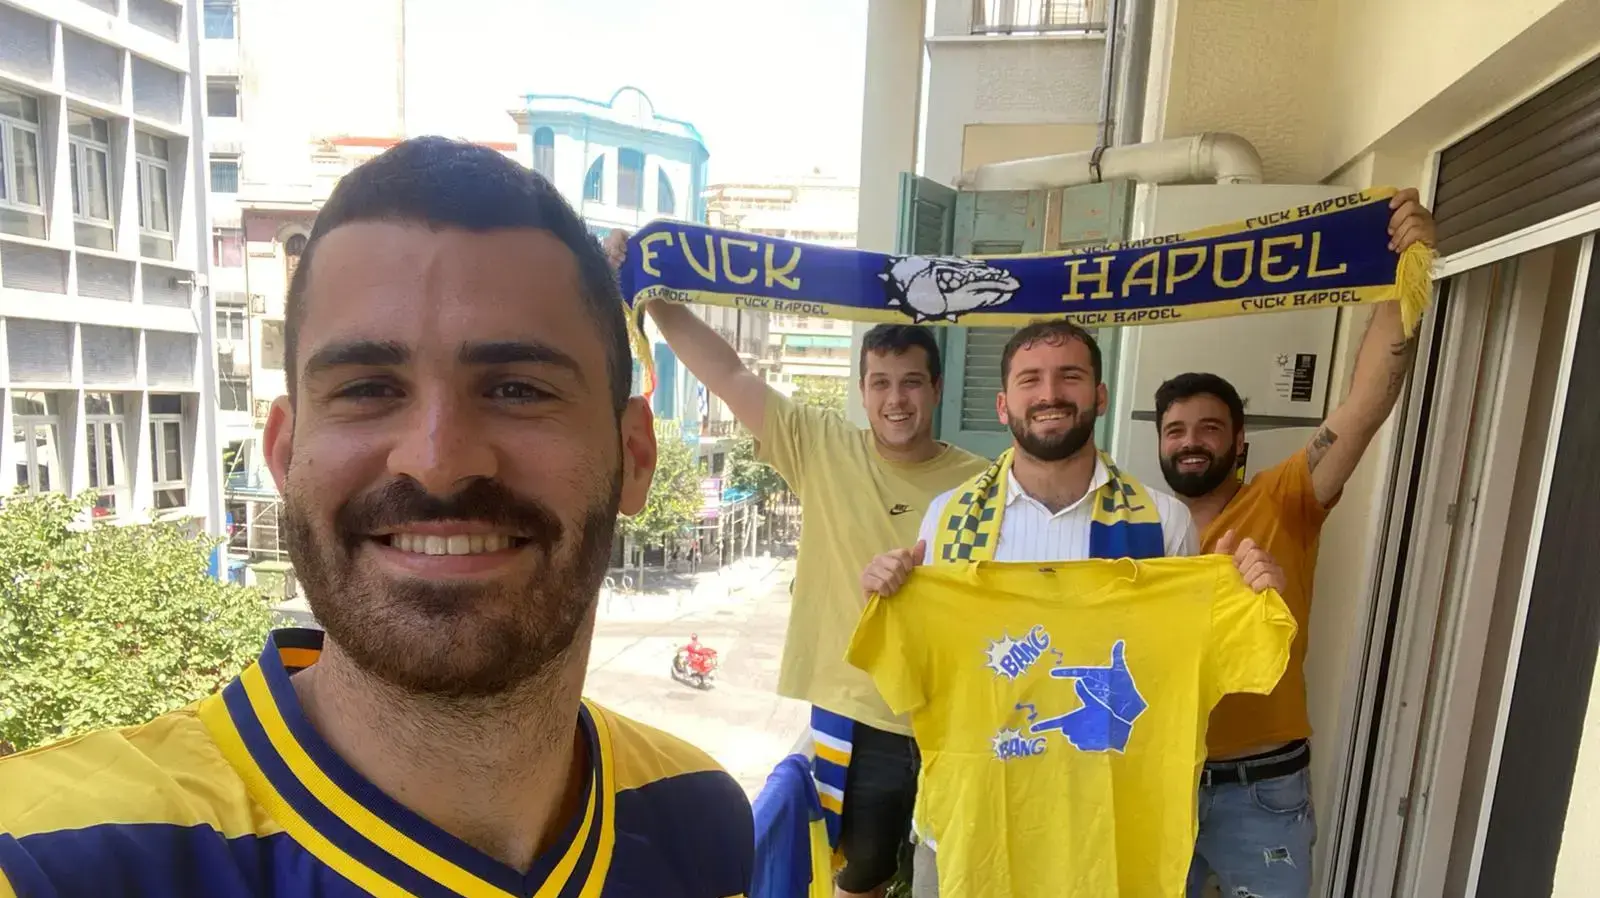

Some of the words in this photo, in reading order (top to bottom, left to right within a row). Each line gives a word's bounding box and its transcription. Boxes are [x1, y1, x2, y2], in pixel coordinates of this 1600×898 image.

[1297, 191, 1371, 217] HAPOEL
[1062, 231, 1347, 301] HAPOEL
[774, 300, 830, 316] HAPOEL
[1293, 290, 1362, 306] HAPOEL
[1113, 308, 1182, 324] HAPOEL
[1000, 624, 1050, 678] BANG
[999, 736, 1046, 759] BANG
